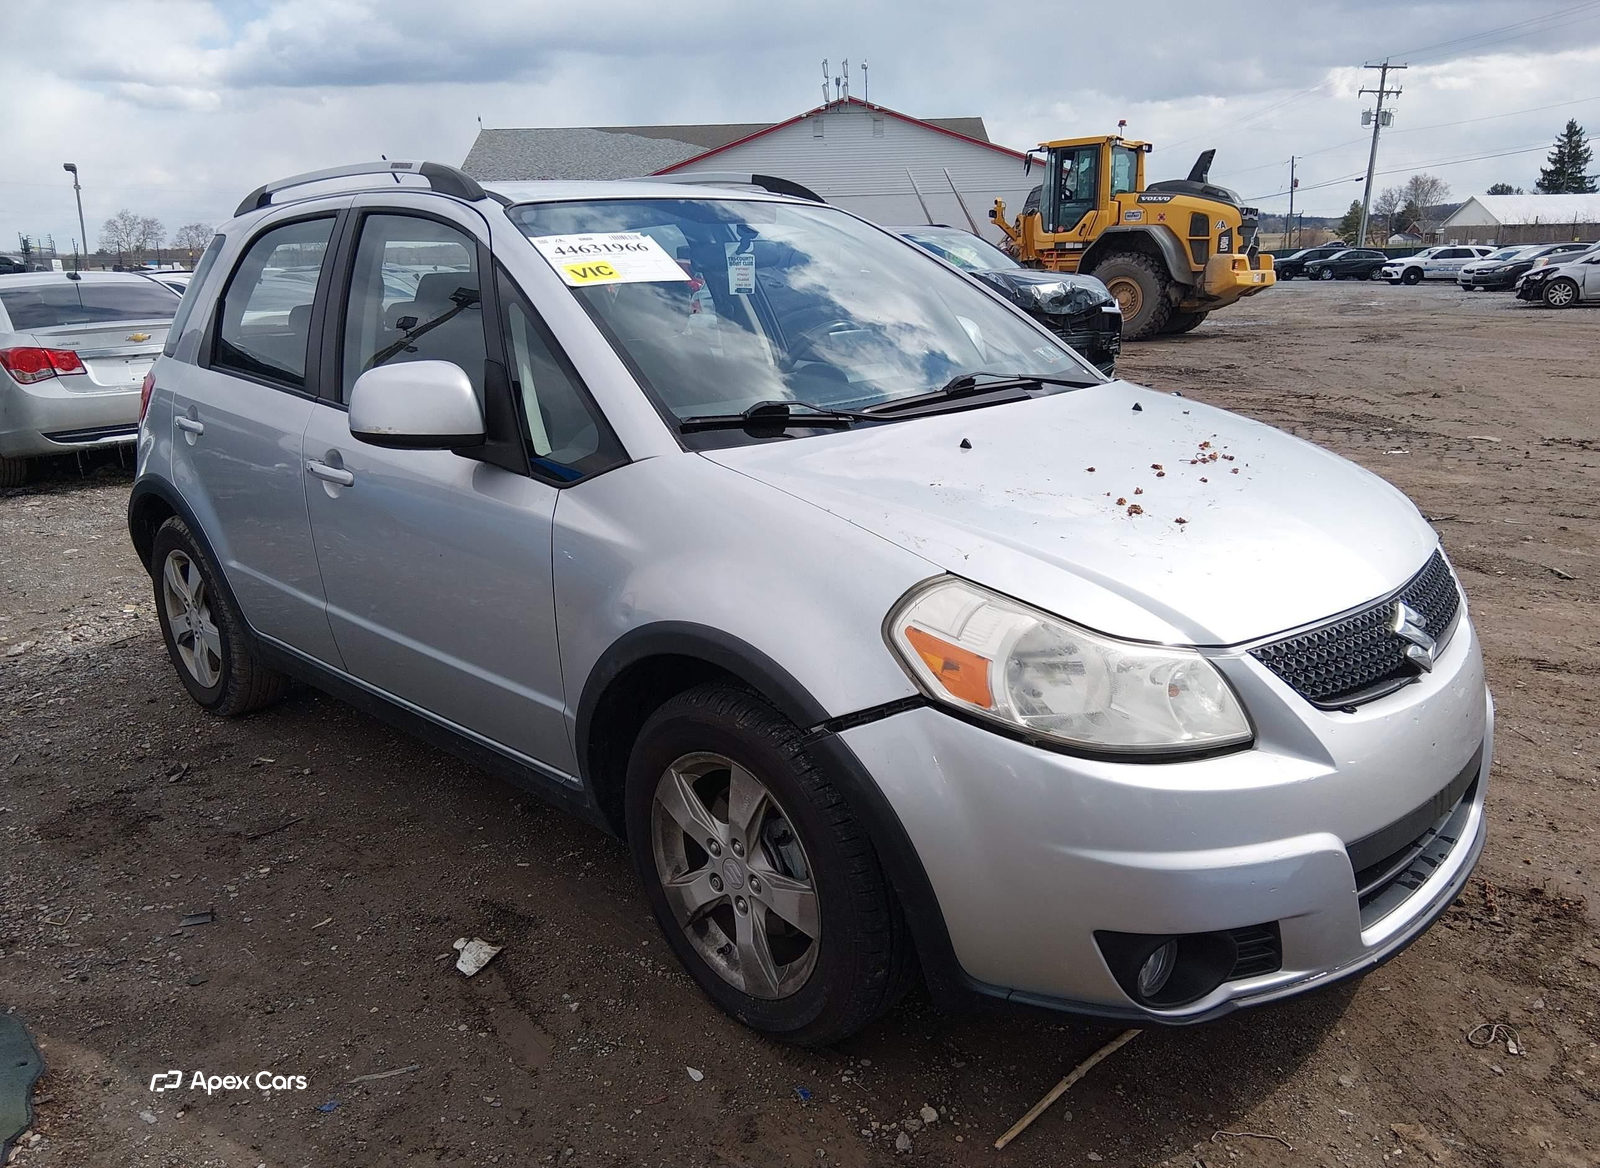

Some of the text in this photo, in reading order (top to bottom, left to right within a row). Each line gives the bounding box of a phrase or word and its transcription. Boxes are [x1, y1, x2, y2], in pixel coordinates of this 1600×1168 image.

[554, 242, 649, 255] 44631966
[1219, 236, 1229, 252] L90H
[570, 265, 614, 279] VIC
